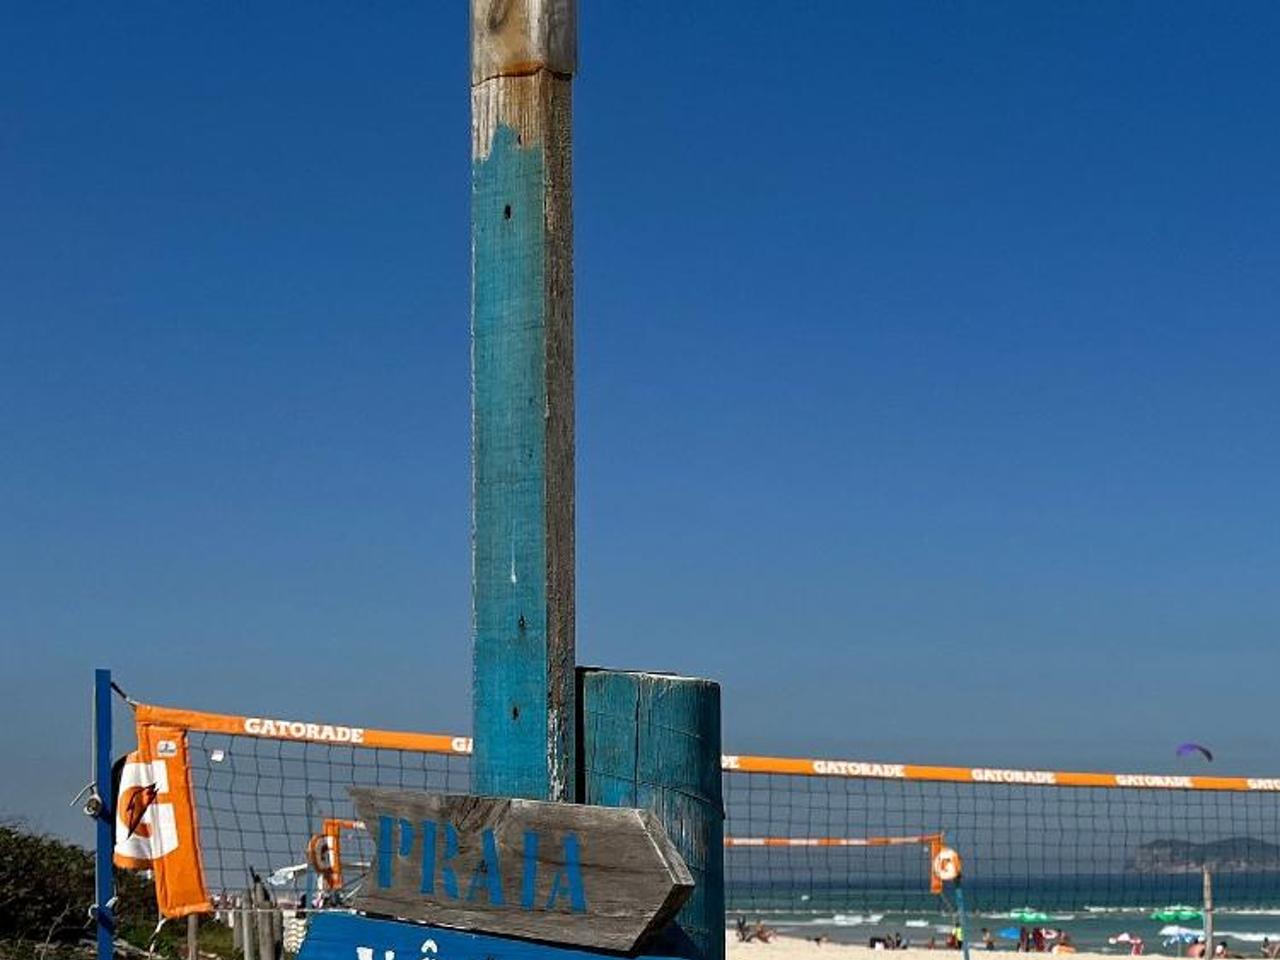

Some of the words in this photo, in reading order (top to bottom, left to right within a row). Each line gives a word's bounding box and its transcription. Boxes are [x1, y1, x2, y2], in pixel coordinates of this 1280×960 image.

[244, 717, 364, 744] GATORADE
[812, 760, 905, 778] GATORADE
[971, 768, 1056, 784] GATORADE
[377, 815, 588, 915] PRAIA
